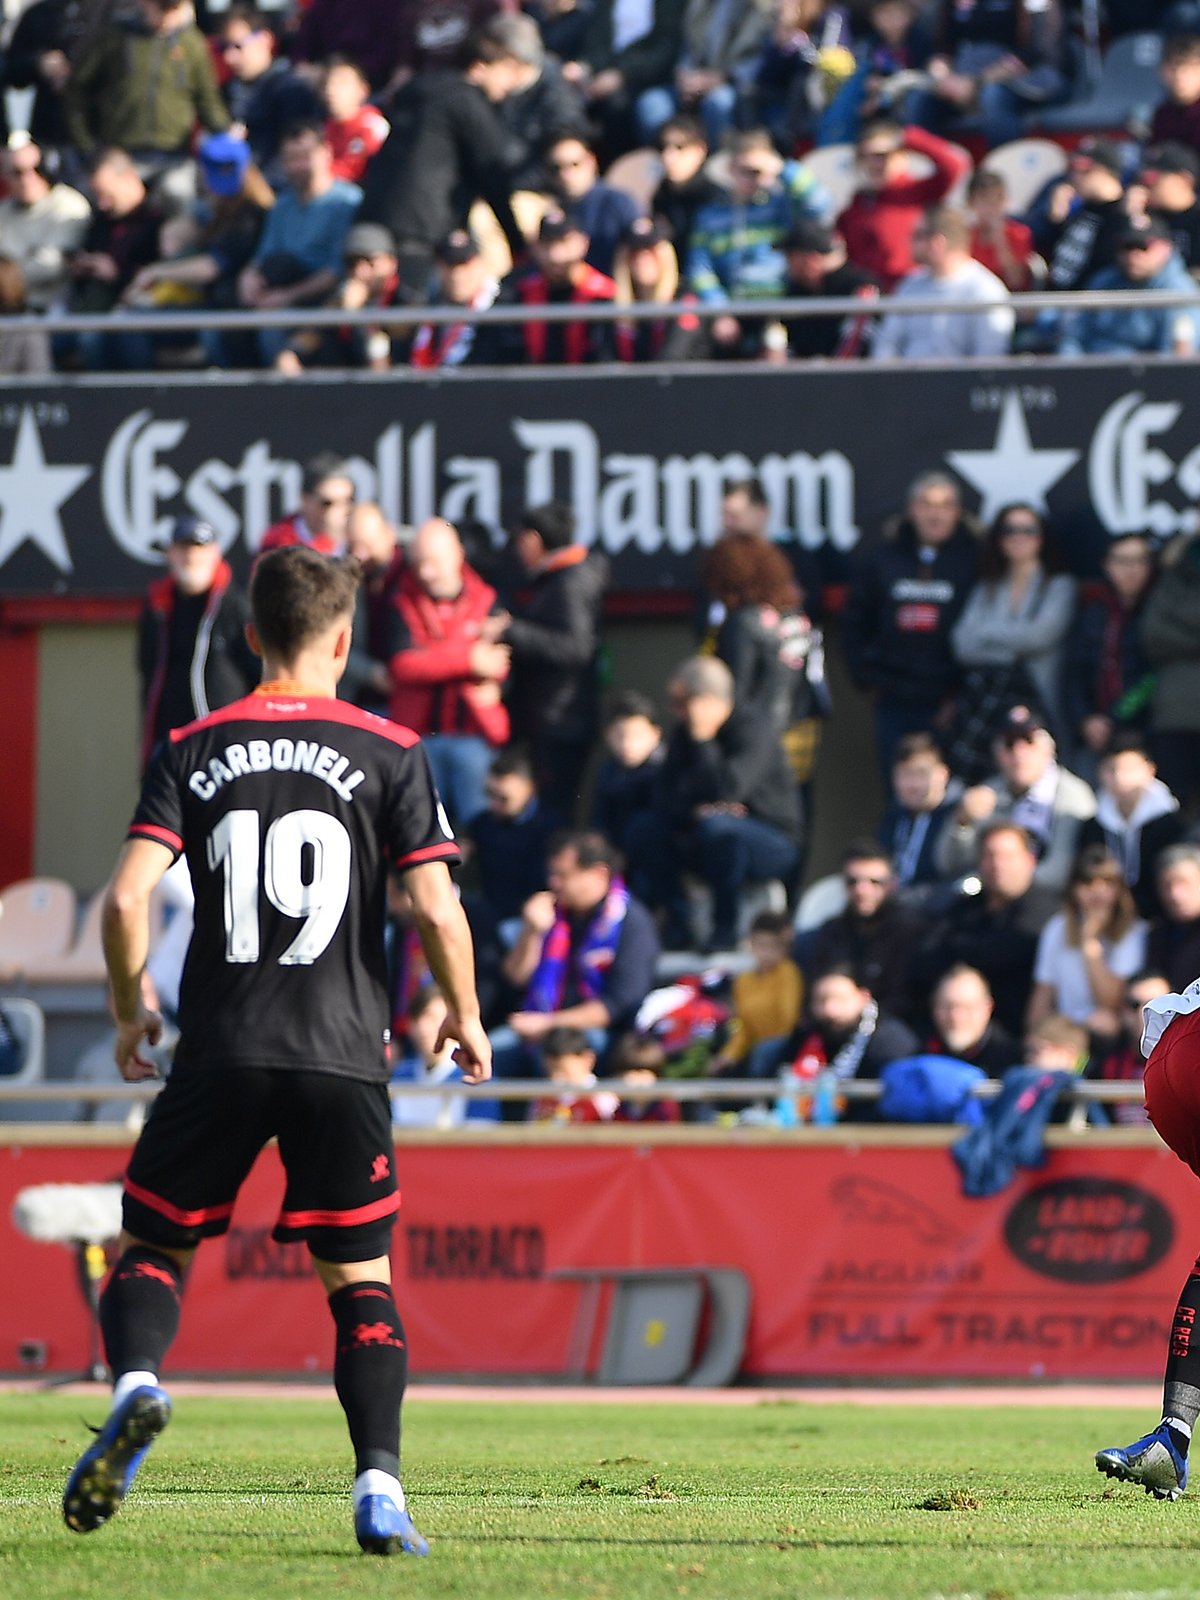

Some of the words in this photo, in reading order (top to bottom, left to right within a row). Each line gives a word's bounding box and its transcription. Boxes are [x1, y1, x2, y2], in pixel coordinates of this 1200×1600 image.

[101, 407, 508, 566] Estrlla
[511, 415, 862, 555] Damm
[188, 738, 366, 801] CARBONELL
[206, 809, 352, 966] 19
[807, 1311, 921, 1346] FULL
[1178, 1305, 1197, 1324] CF
[1172, 1326, 1192, 1358] REUS
